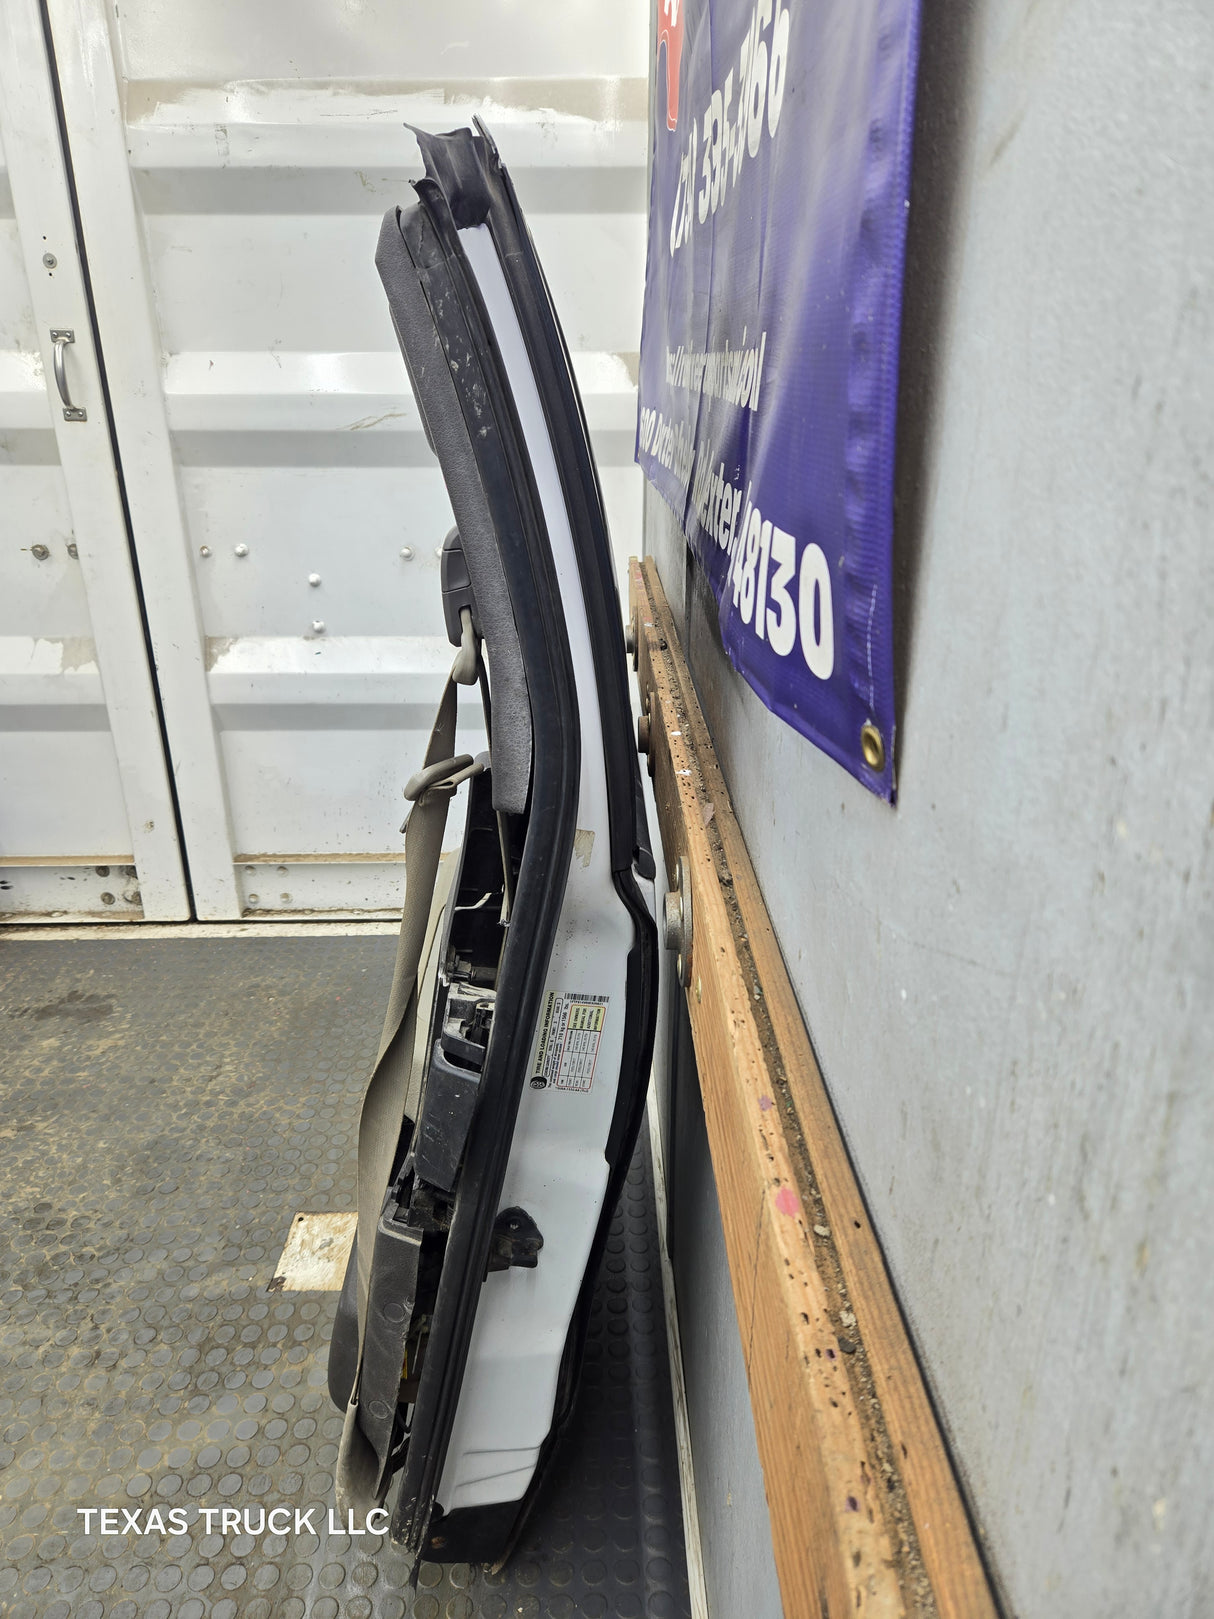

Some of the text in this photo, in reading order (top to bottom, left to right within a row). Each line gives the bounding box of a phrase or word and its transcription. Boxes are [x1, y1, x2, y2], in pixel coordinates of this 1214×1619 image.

[733, 501, 834, 680] 48130
[540, 1028, 548, 1050] LOADING
[544, 992, 555, 1028] INFORMATION
